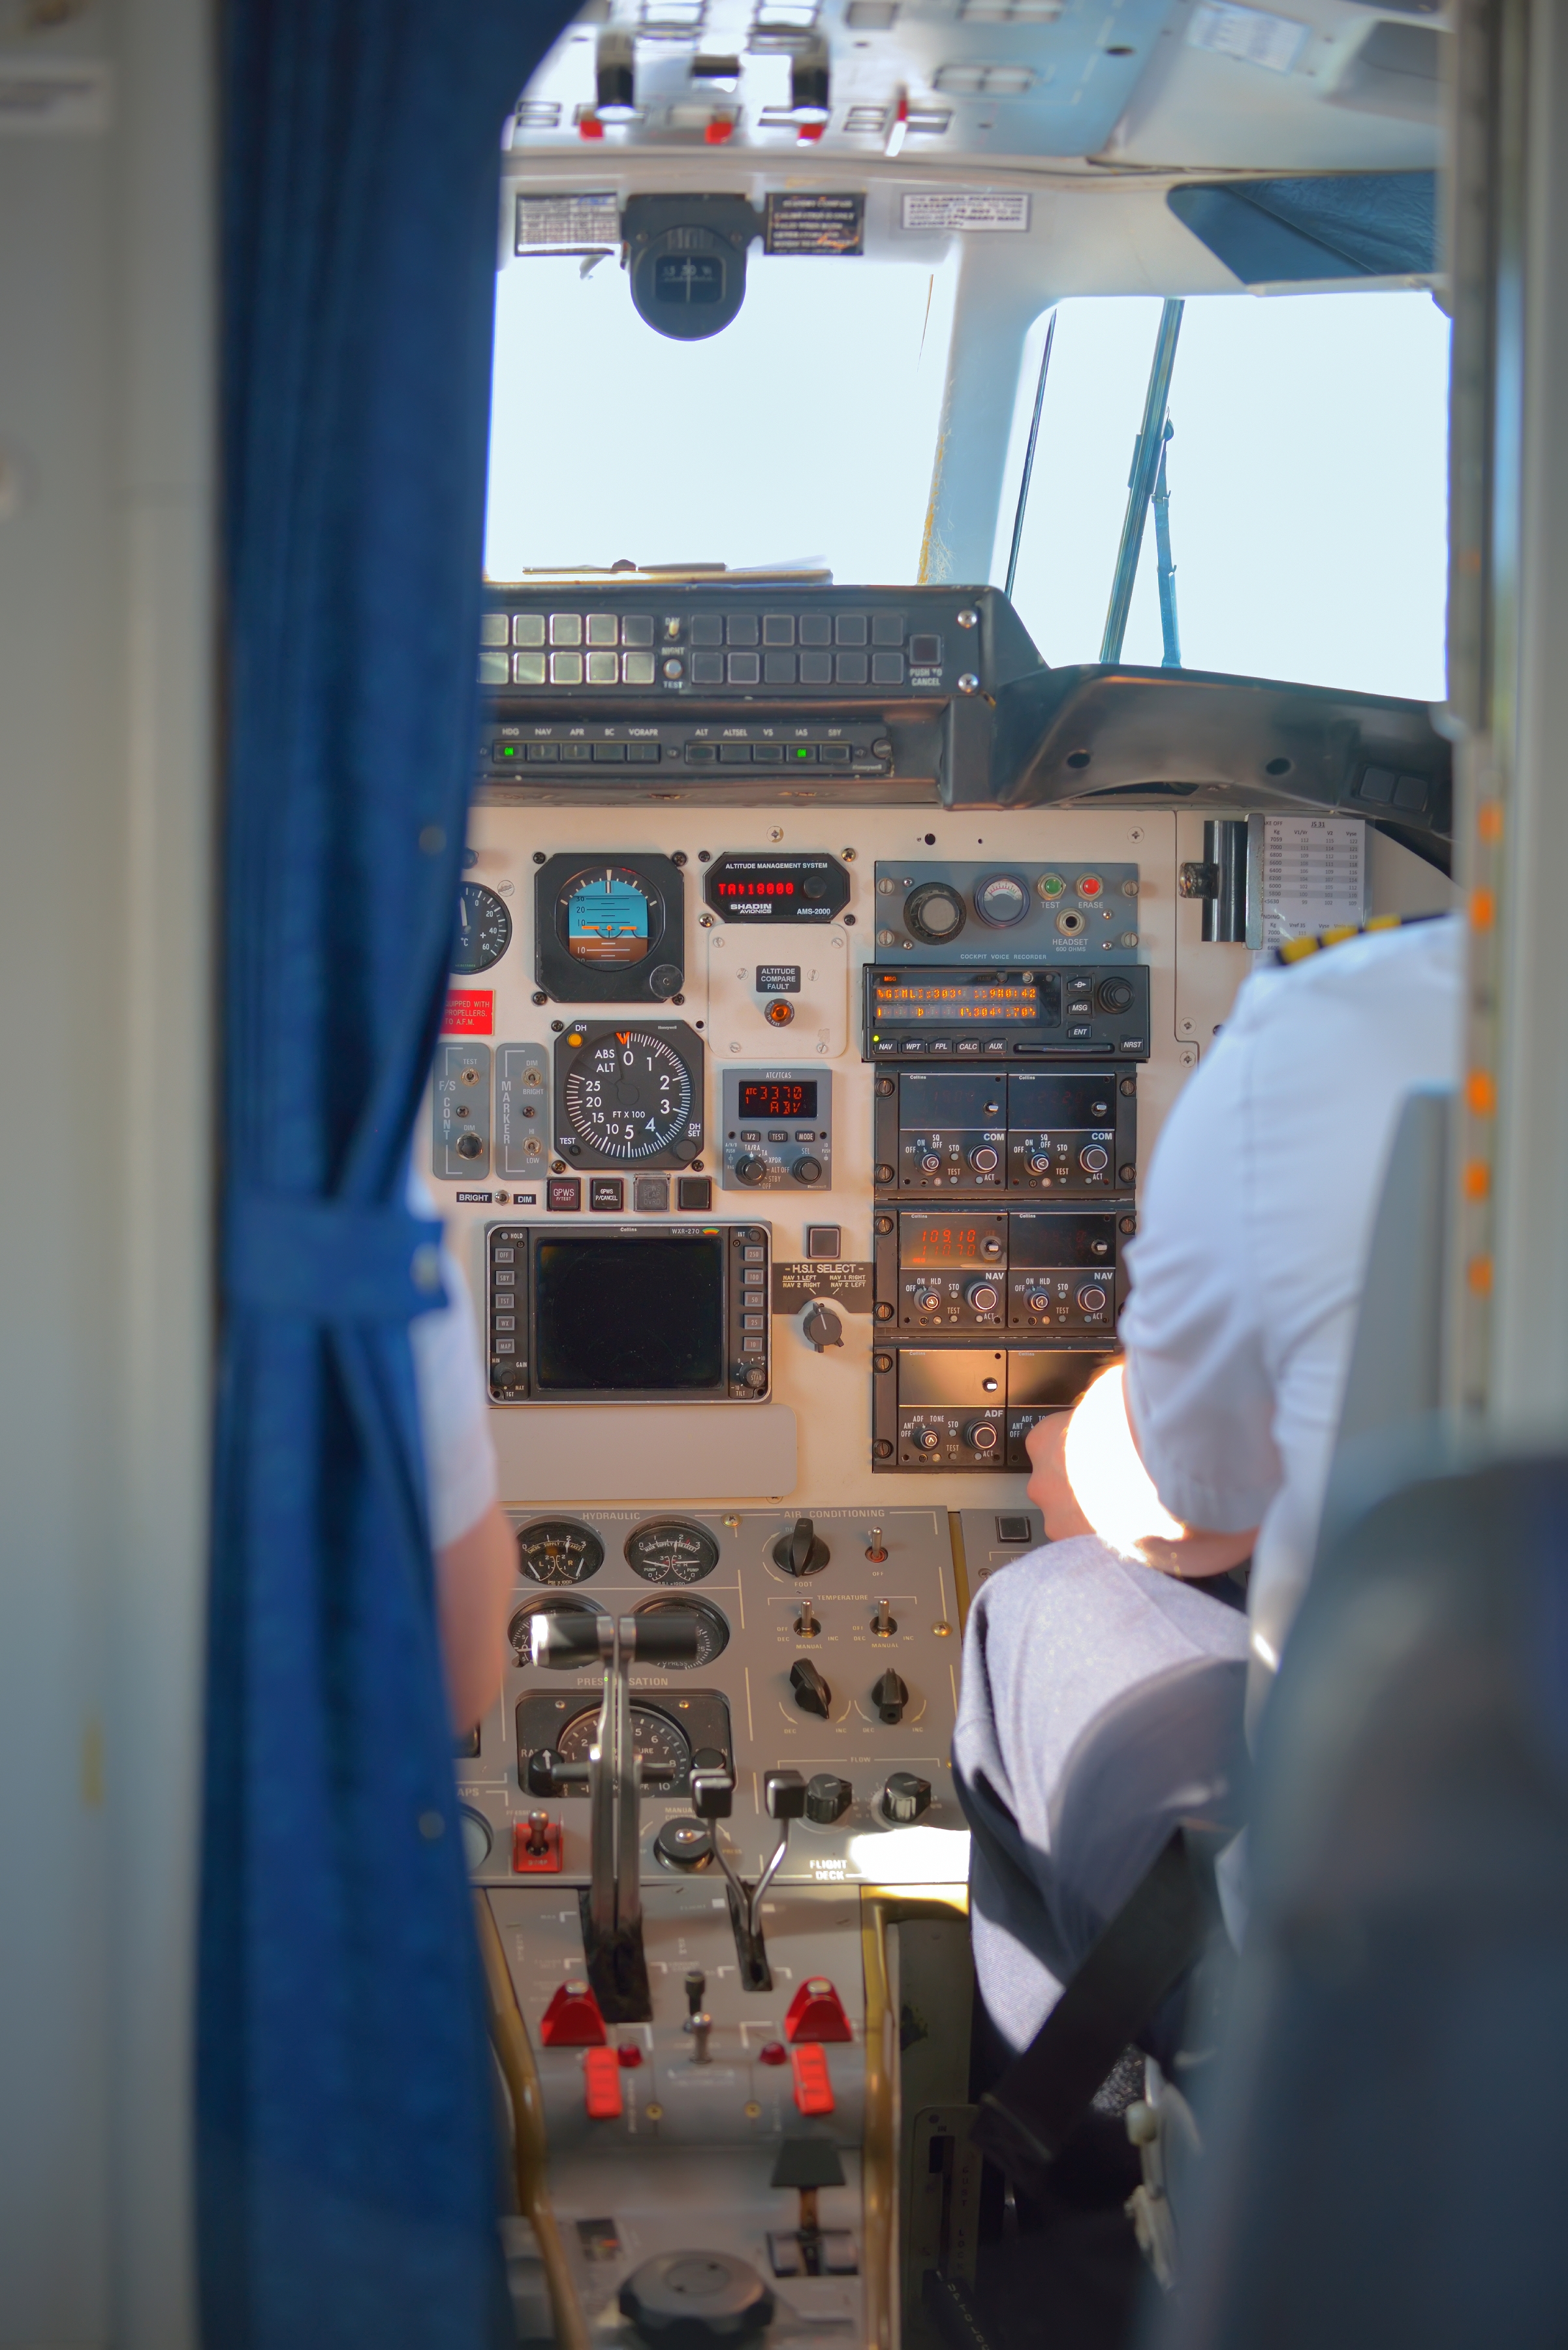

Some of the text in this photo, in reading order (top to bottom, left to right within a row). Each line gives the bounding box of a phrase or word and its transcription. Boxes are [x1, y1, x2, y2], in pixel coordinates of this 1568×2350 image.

[595, 1050, 615, 1058] ABS
[623, 1051, 633, 1065] 0
[597, 1063, 614, 1073] ALT
[646, 1058, 653, 1071] 1
[439, 1080, 456, 1091] F/S
[586, 1081, 601, 1091] 25
[660, 1075, 670, 1089] 2
[586, 1097, 602, 1107] 20
[661, 1099, 670, 1114] 3
[592, 1113, 604, 1123] 15
[606, 1124, 619, 1134] 10
[645, 1118, 656, 1131] 4
[624, 1125, 634, 1139] 5
[792, 1264, 856, 1273] H.S.I. SELECT
[809, 1509, 885, 1518] CONDITIONING
[809, 1860, 847, 1869] FLIGHT
[816, 1871, 844, 1880] DECK
